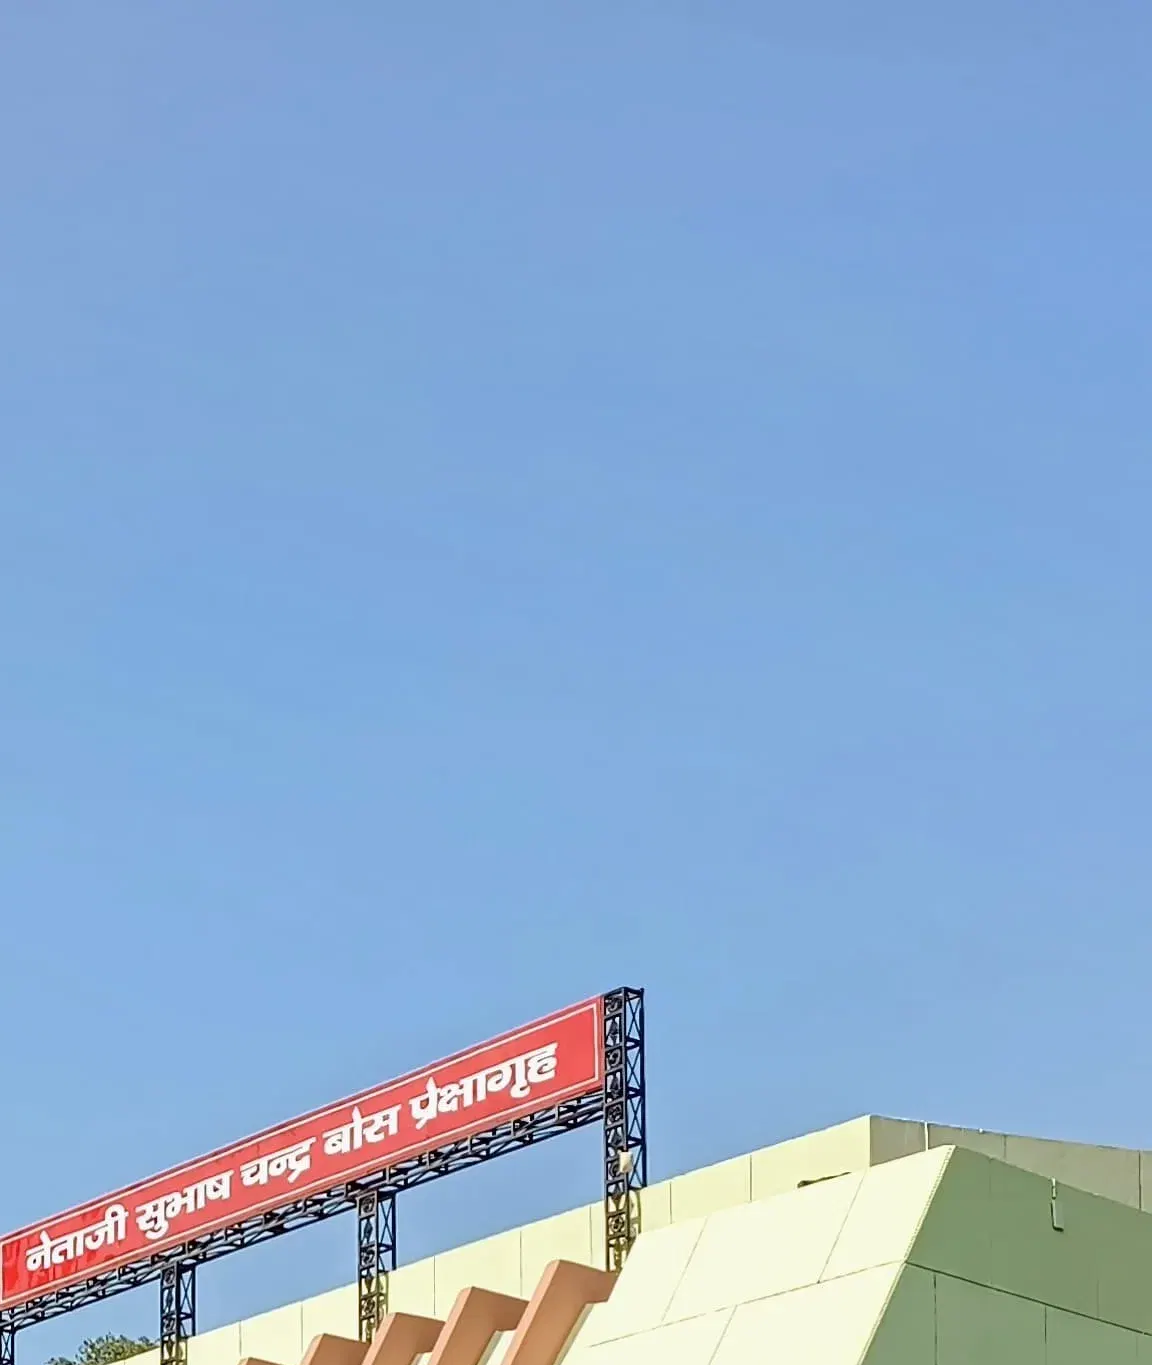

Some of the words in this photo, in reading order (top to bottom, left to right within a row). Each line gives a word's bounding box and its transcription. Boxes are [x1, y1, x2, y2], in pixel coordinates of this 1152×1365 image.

[25, 1204, 129, 1271] नेताजी
[135, 1169, 234, 1240] सुभाष
[239, 1136, 317, 1184] चन्द्र
[322, 1104, 402, 1155] बोस
[408, 1042, 558, 1130] प्रेक्षागृह
